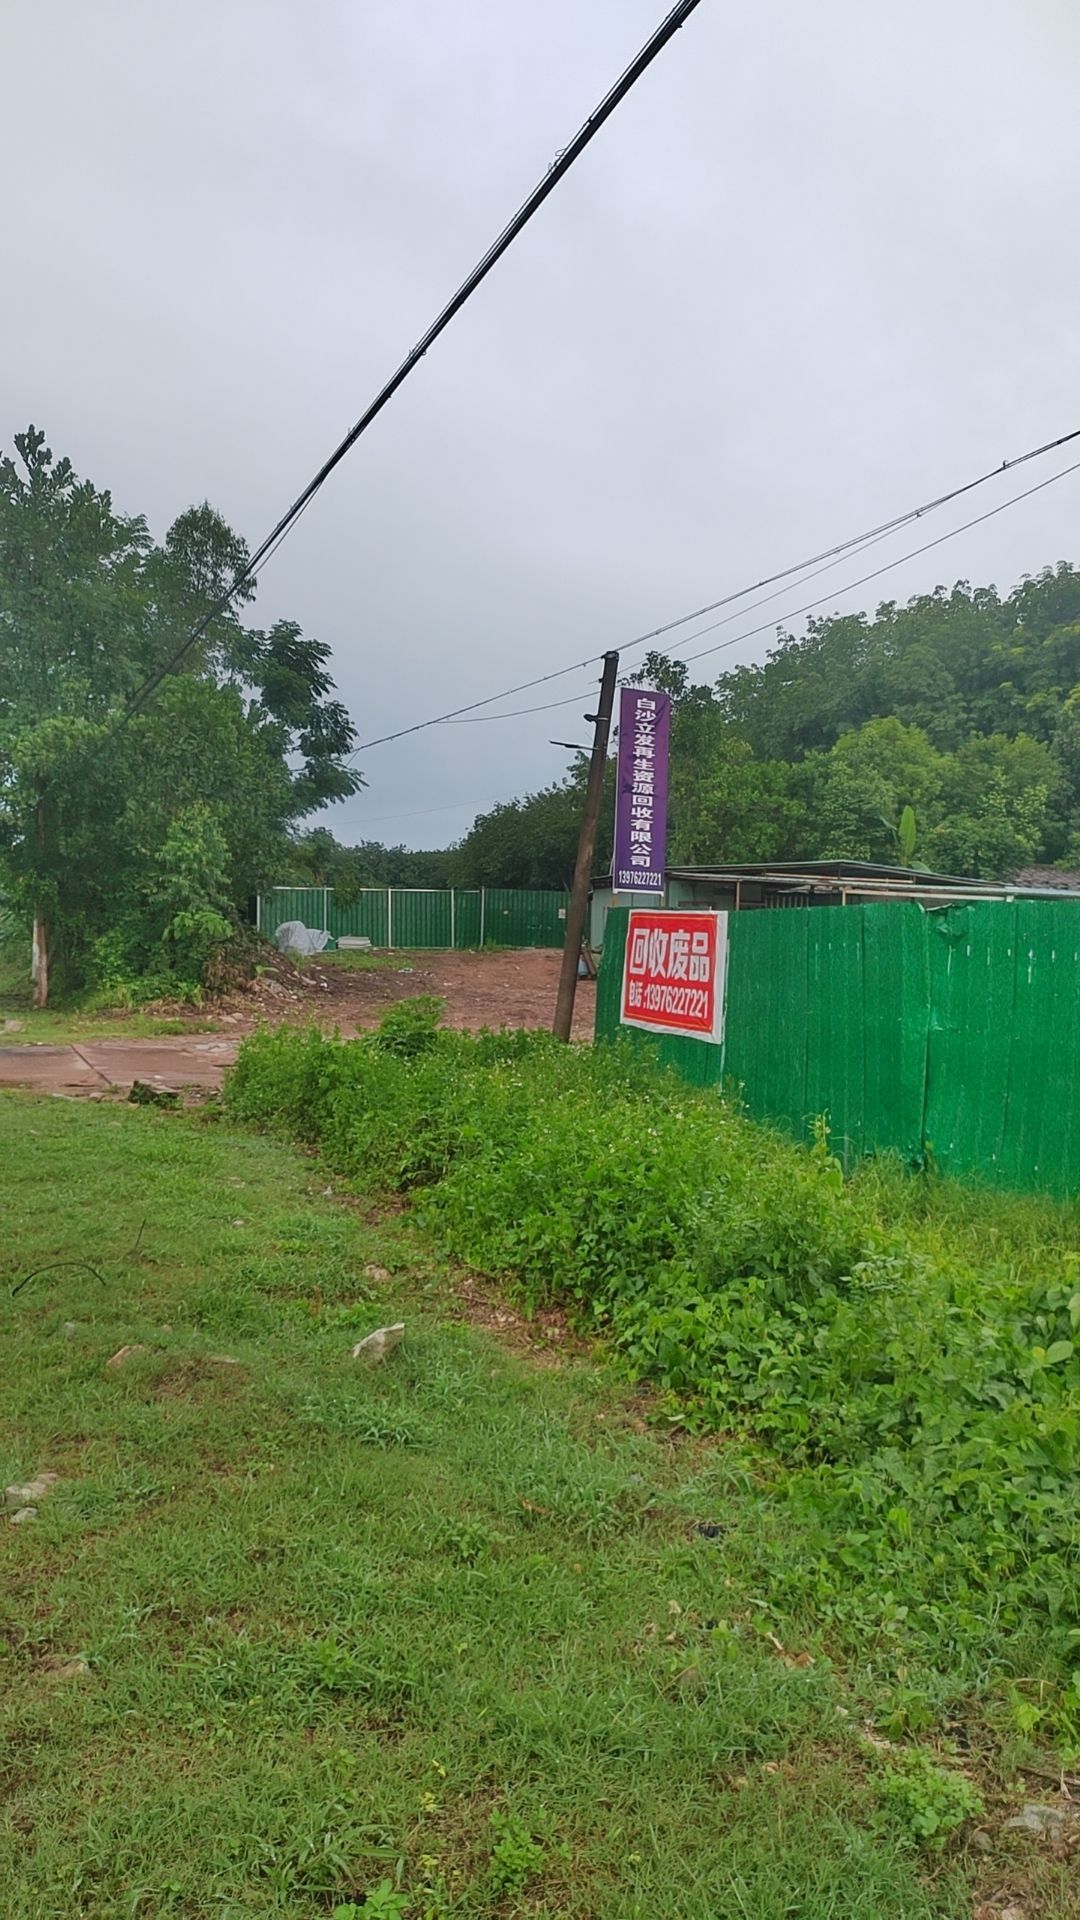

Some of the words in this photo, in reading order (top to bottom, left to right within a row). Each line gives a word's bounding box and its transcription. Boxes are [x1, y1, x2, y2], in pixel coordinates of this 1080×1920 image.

[630, 698, 656, 867] 白沙立发再生资源回收有限公司
[618, 870, 662, 886] 13976227221
[629, 928, 710, 982] 回收废品
